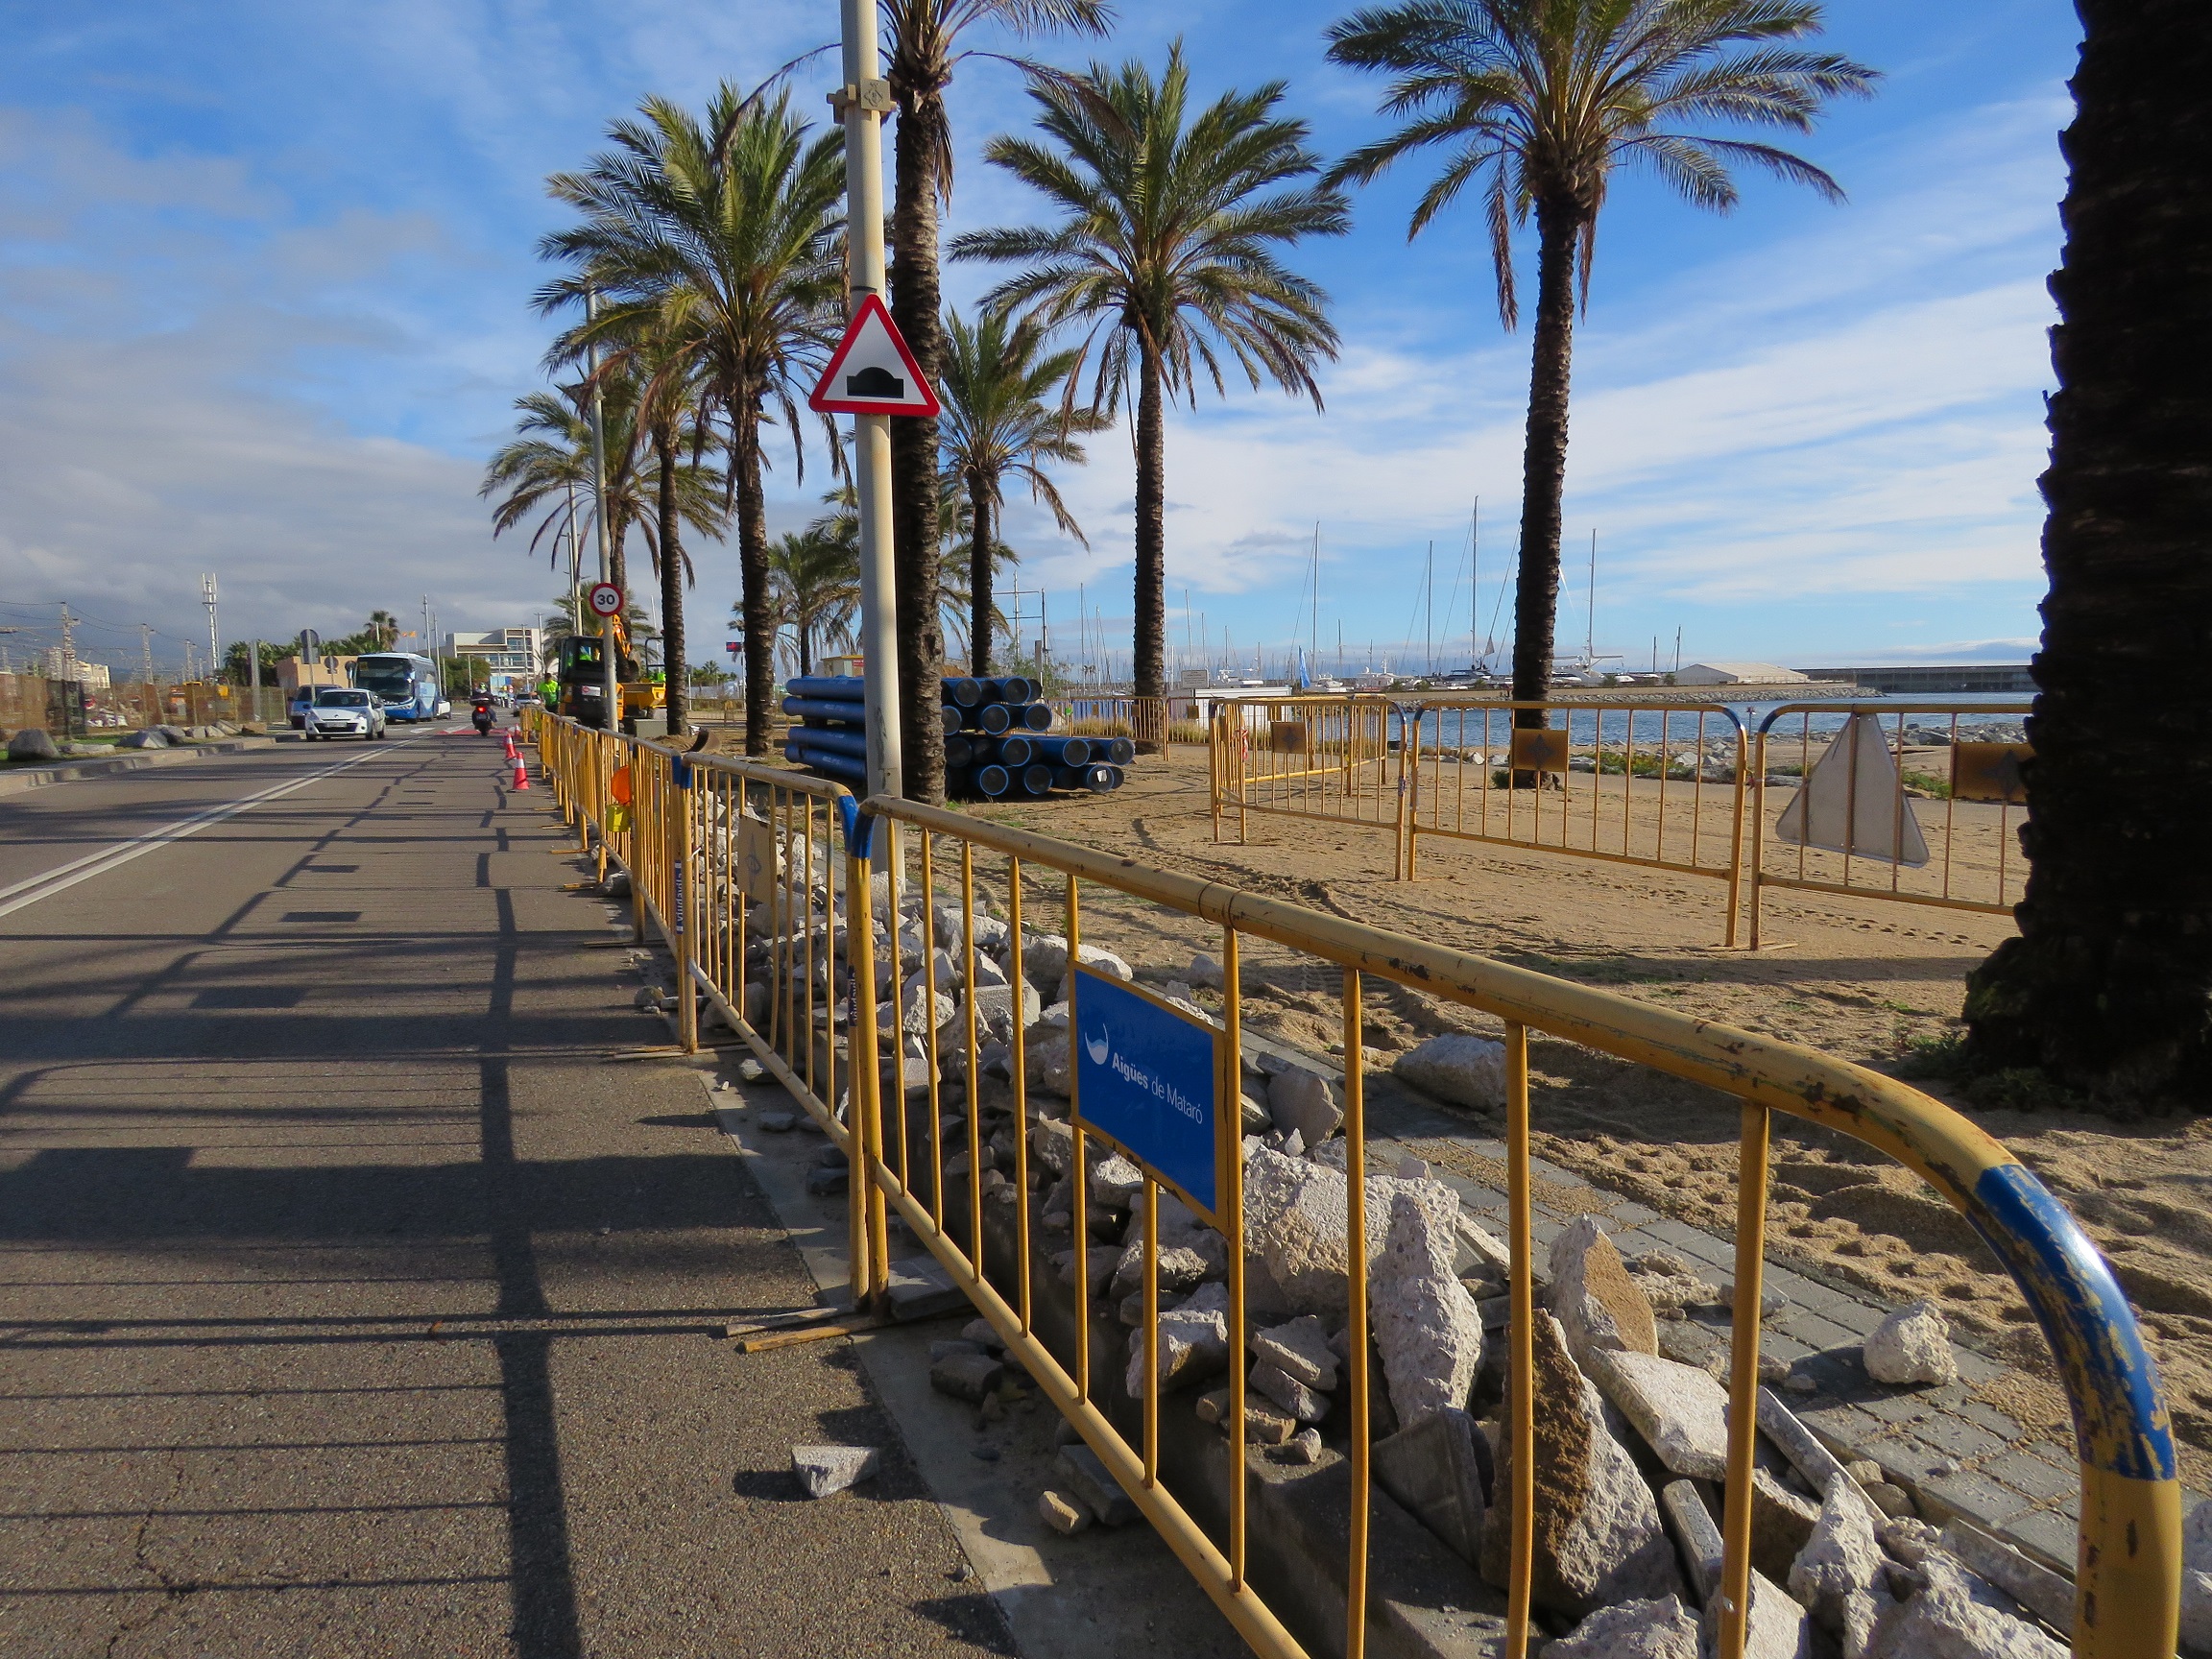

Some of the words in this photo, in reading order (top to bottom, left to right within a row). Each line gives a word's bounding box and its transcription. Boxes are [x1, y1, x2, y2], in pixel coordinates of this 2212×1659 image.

[597, 593, 615, 605] 30
[1112, 1052, 1148, 1090] Aigües
[1151, 1075, 1166, 1100] de
[1166, 1083, 1203, 1125] Mataró
